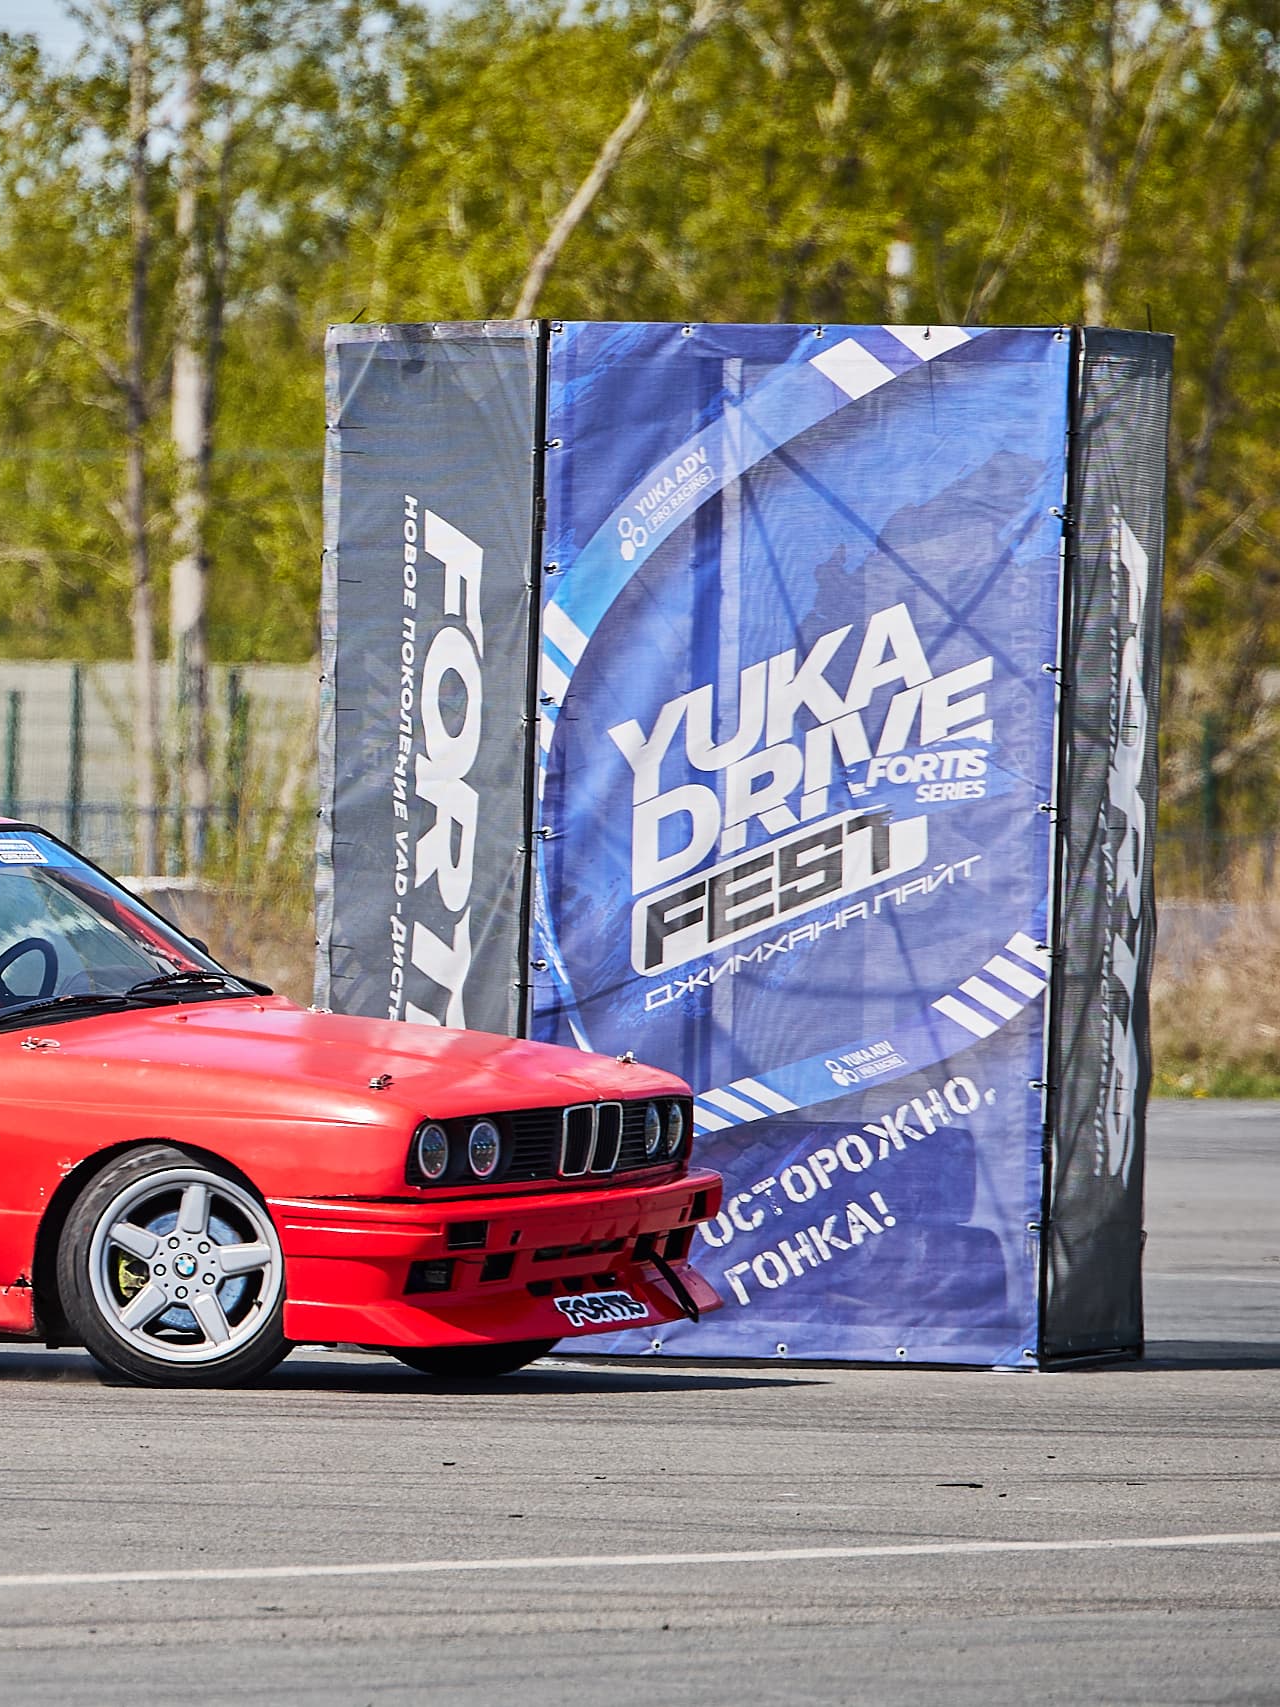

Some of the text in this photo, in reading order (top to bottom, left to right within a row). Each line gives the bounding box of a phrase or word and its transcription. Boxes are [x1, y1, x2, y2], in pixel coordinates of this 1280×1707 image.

[634, 446, 708, 517] YUKA ADV
[403, 494, 418, 610] НОВОЕ
[393, 617, 416, 821] ПОКОЛЕНИЕ
[607, 602, 934, 807] YUKA
[631, 655, 994, 896] DRIVE
[866, 747, 990, 789] FORTIS
[915, 779, 987, 804] SERIES
[393, 831, 409, 897] VAD
[643, 810, 893, 971] FEST
[643, 900, 869, 1012] ДЖИМХАНА
[723, 1191, 897, 1306] ГОНКА!
